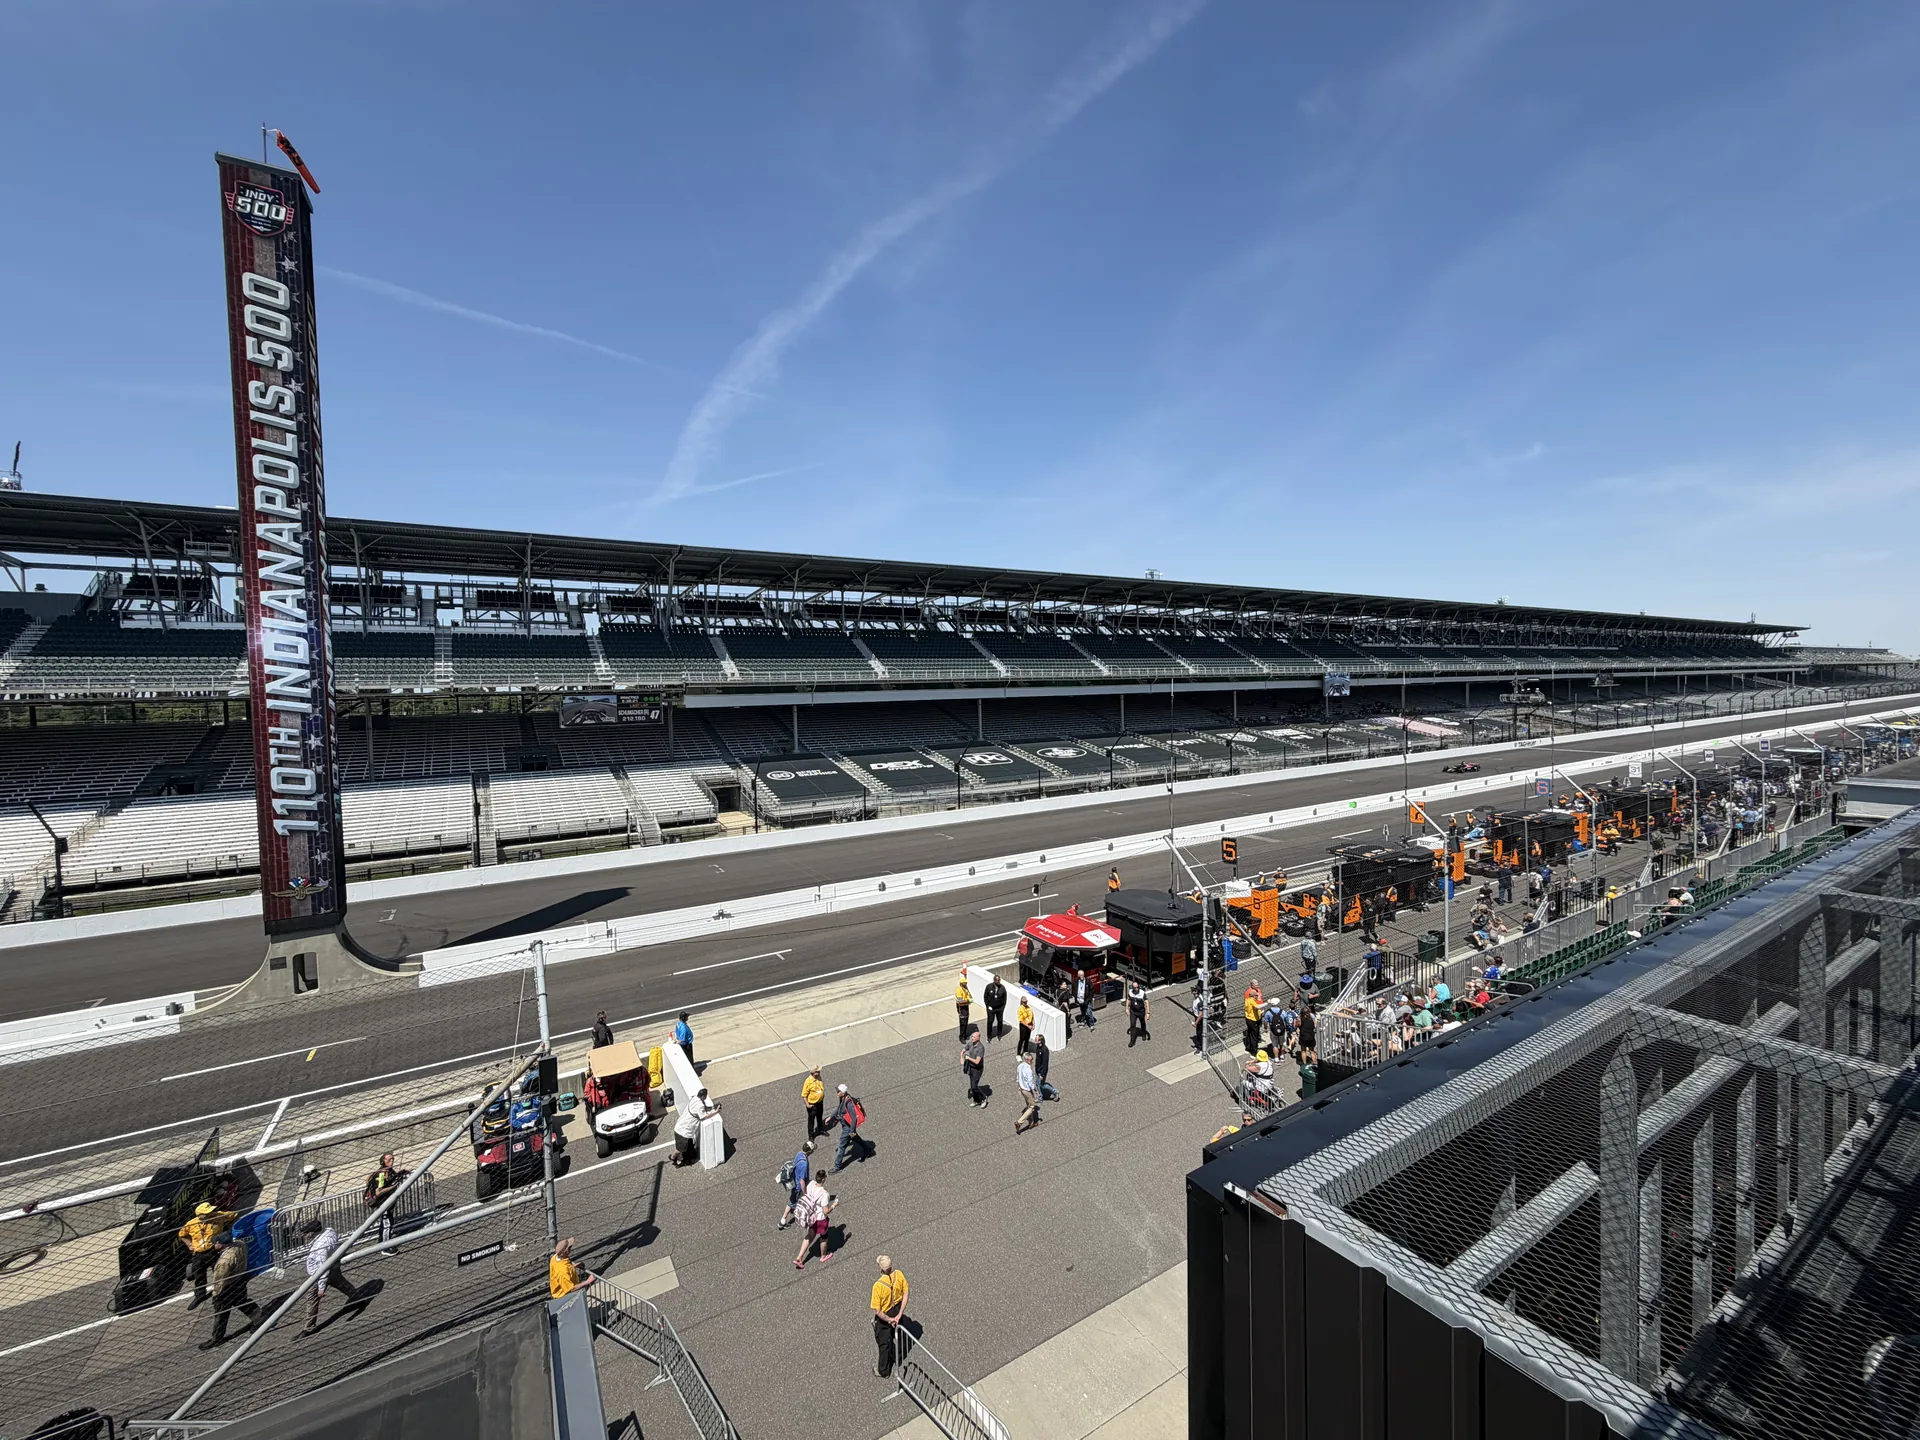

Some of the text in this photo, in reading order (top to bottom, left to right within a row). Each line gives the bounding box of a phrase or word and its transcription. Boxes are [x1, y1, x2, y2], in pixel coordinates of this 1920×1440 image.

[245, 189, 274, 203] INDY
[234, 195, 287, 221] 500
[241, 271, 294, 372] 500
[248, 380, 313, 714] INDIANAPOLIS
[650, 710, 660, 720] 47
[965, 754, 1009, 764] PPG
[267, 726, 320, 836] 110TH
[1536, 780, 1549, 795] 6
[1222, 840, 1236, 861] 5
[1252, 897, 1261, 910] 5
[1035, 924, 1067, 940] Firestone
[471, 1244, 500, 1259] SMOKING
